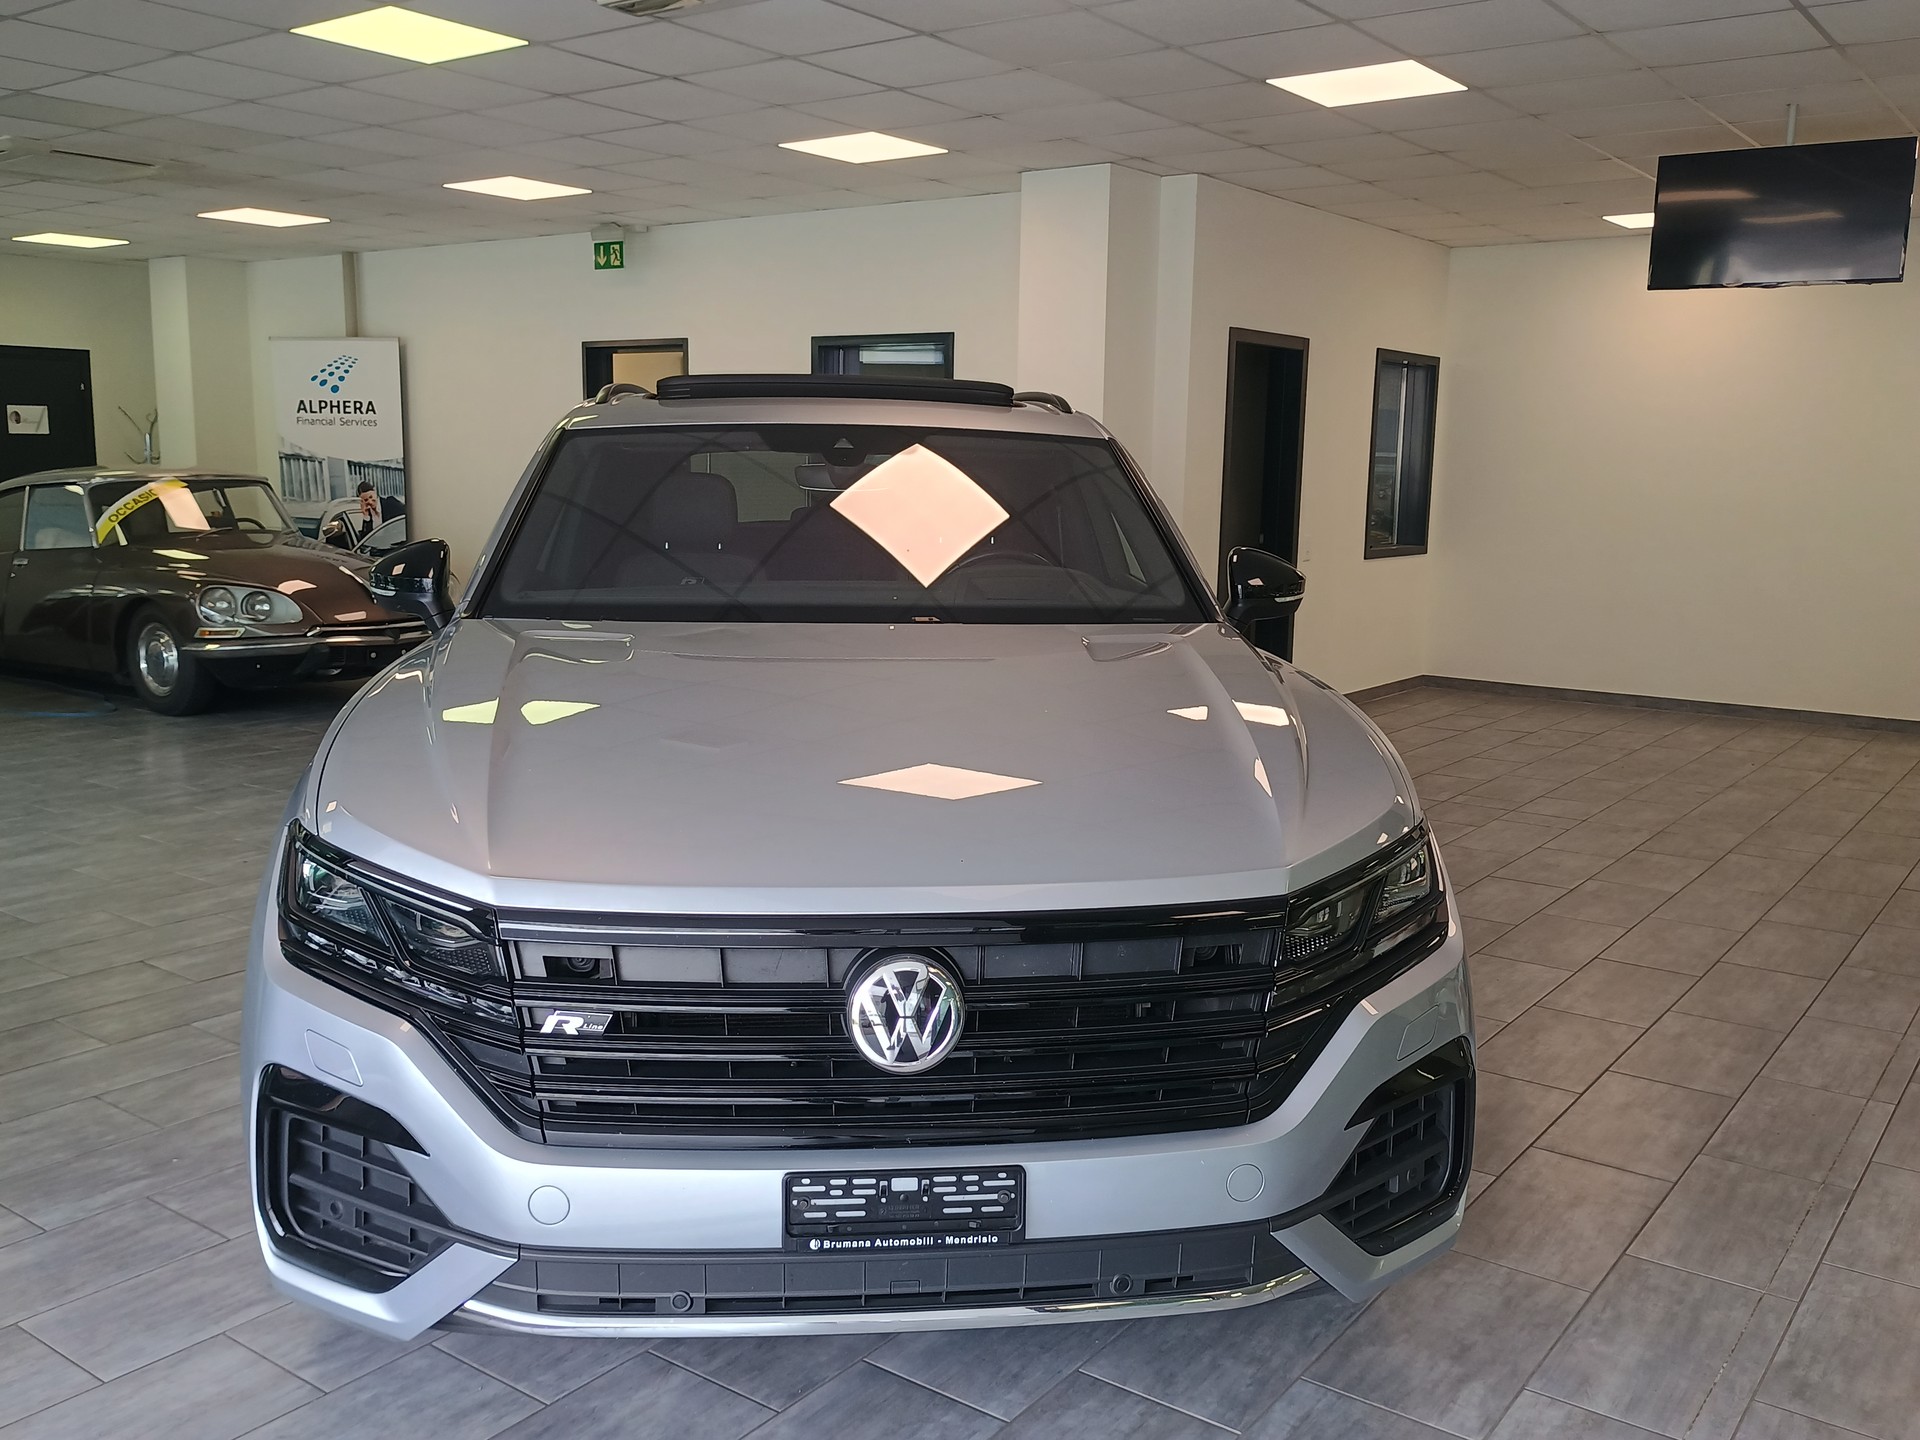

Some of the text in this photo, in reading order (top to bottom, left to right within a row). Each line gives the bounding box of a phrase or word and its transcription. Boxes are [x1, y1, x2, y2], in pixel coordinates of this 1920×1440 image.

[296, 399, 377, 415] ALPHERA
[296, 416, 378, 427] Financial Services
[540, 1013, 585, 1035] R
[822, 1239, 871, 1249] Brumana
[874, 1236, 934, 1248] Automobili
